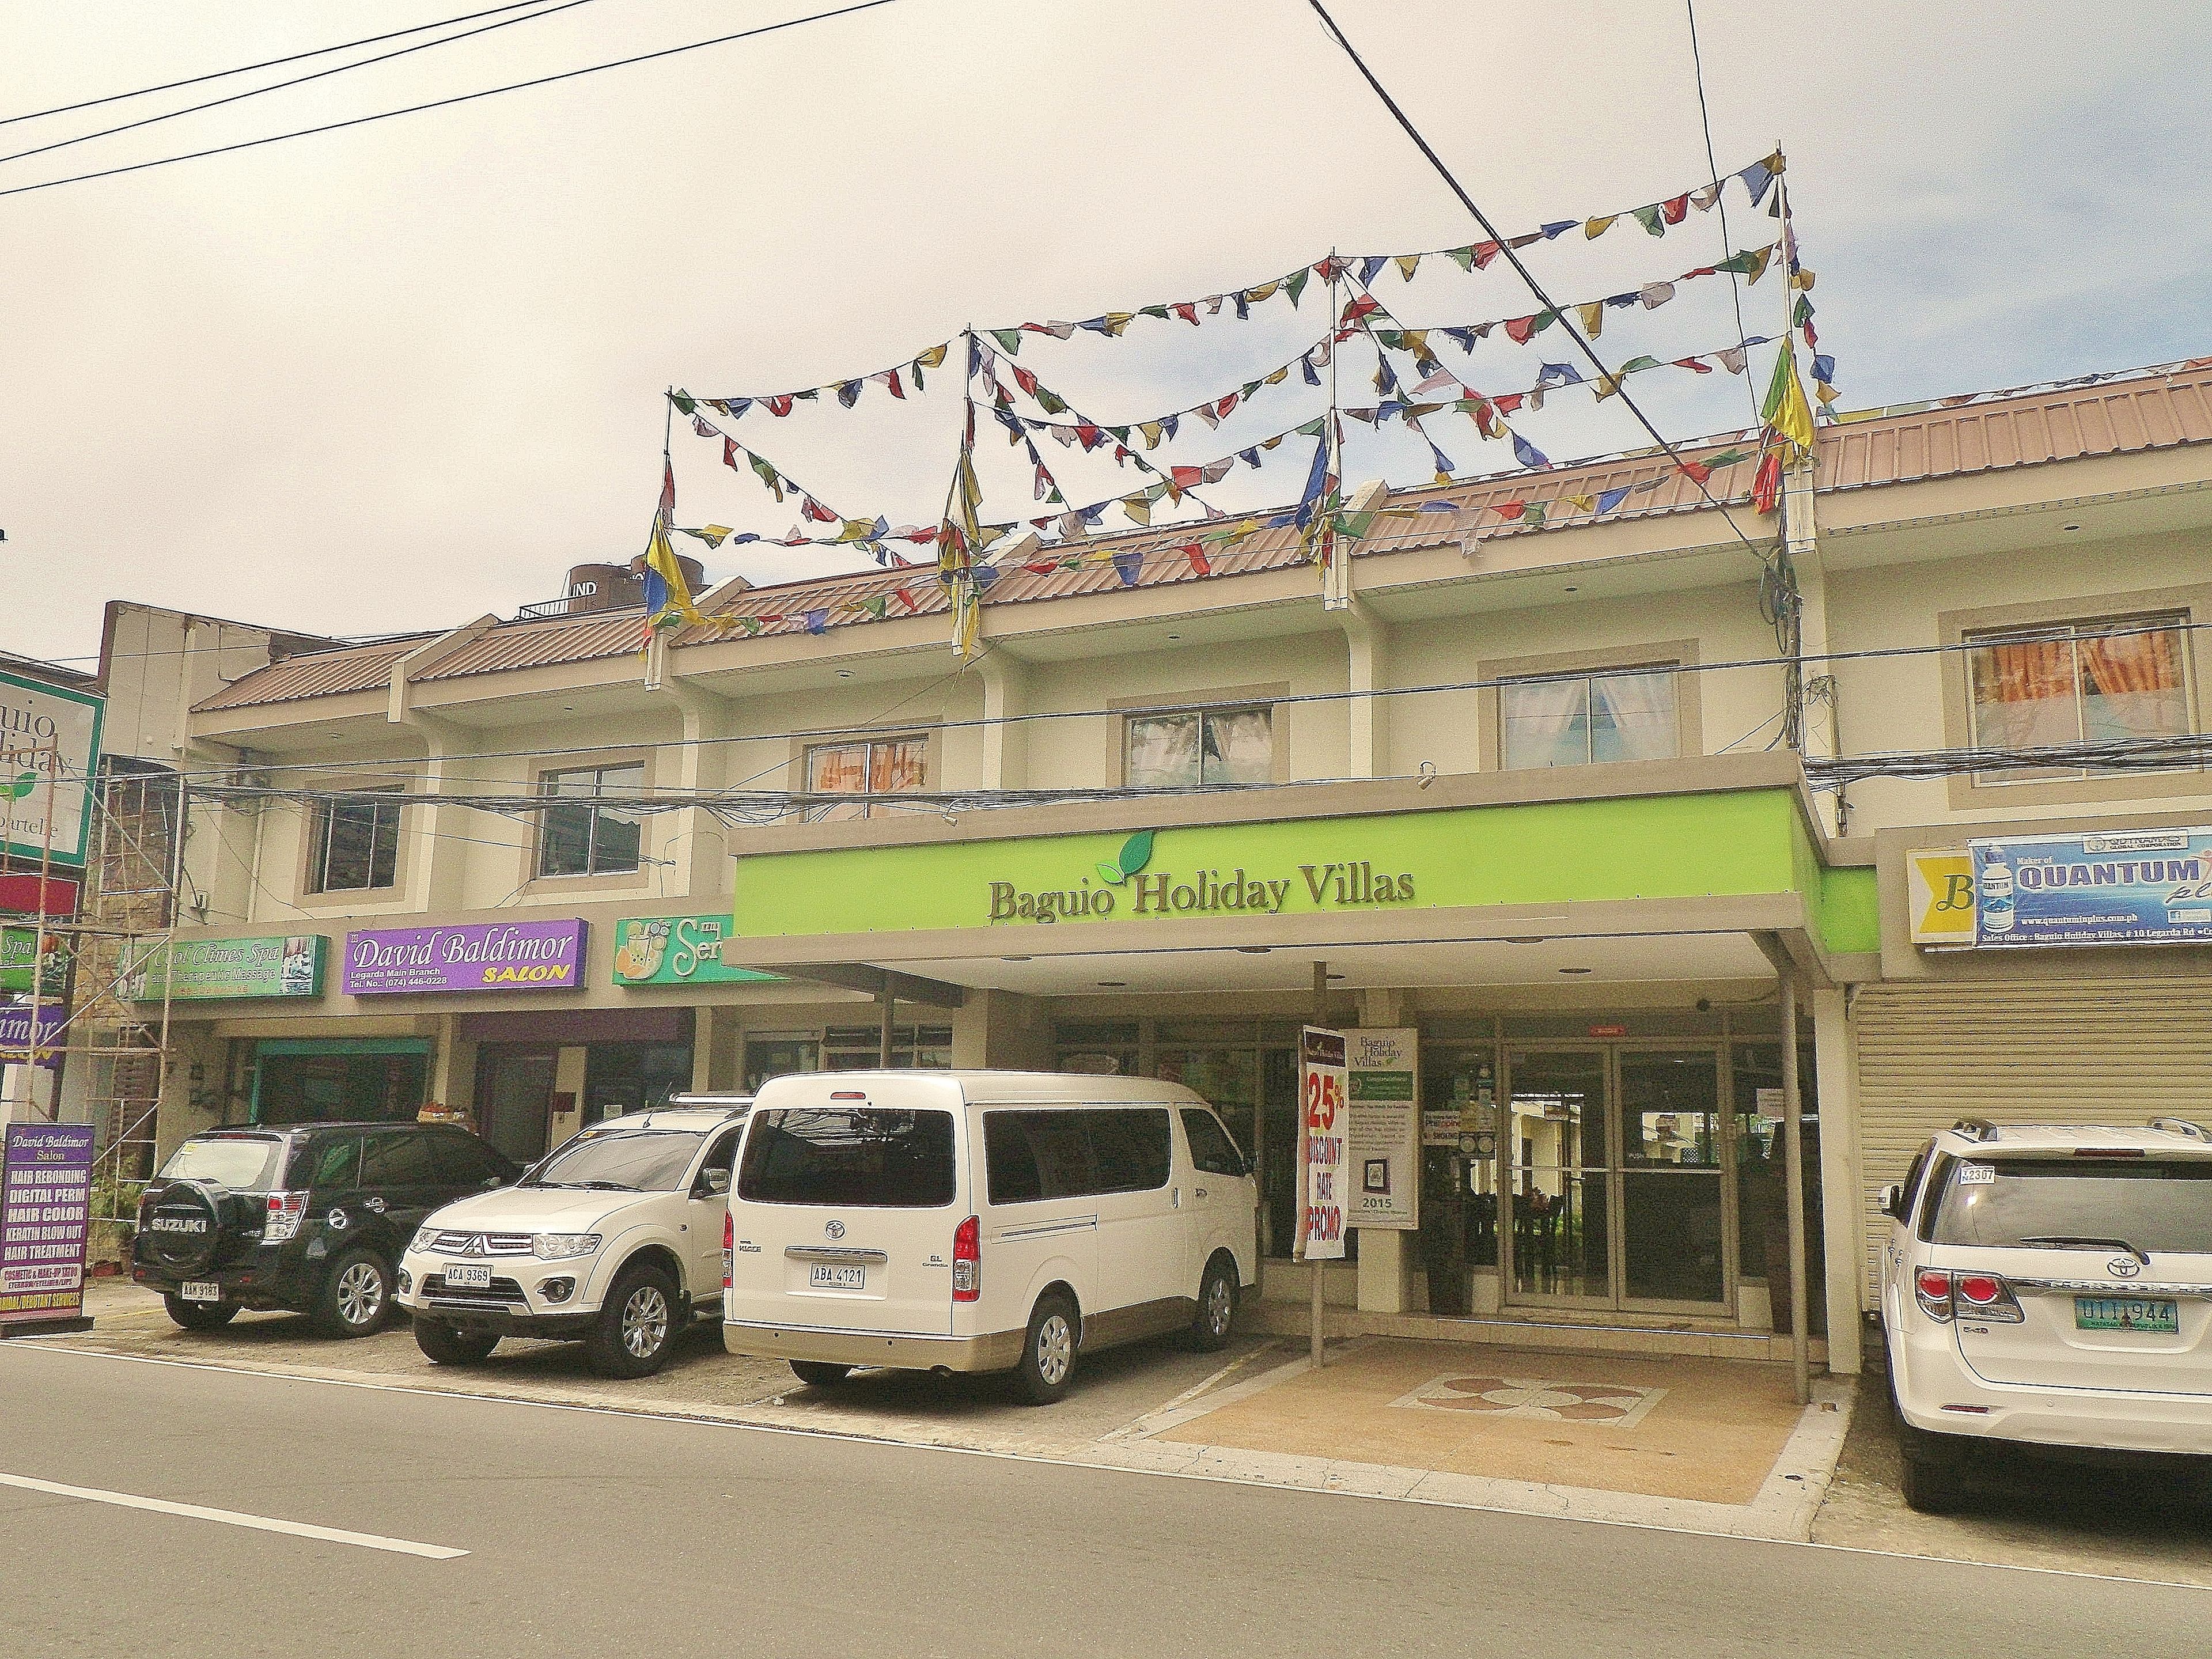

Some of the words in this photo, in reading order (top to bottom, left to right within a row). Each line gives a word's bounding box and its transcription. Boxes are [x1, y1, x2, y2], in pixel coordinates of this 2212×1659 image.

[2017, 857, 2041, 866] Maker
[2044, 856, 2054, 865] of
[2019, 859, 2199, 890] QUANTUM
[987, 877, 1115, 923] Baguio
[1132, 869, 1290, 914] Holiday
[1298, 861, 1415, 904] Villas
[1936, 874, 1974, 912] B
[1982, 933, 2003, 942] Sales
[2004, 933, 2027, 942] Office
[2035, 931, 2063, 941] Baguio
[2065, 930, 2098, 941] Holiday
[2134, 929, 2145, 938] 10
[2146, 927, 2181, 938] Legarda
[2182, 927, 2194, 936] Rd
[3, 935, 31, 960] Spa
[154, 944, 194, 967] Col
[193, 942, 244, 966] Climes
[247, 944, 279, 967] Spa
[353, 930, 442, 969] David
[441, 926, 573, 964] Baldimor
[232, 967, 276, 983] Massage
[350, 971, 385, 980] Legarda
[387, 969, 407, 977] Main
[408, 968, 440, 976] Branch
[350, 980, 363, 988] Tel.
[385, 979, 407, 987] (074)
[408, 976, 448, 986] 446-0228
[482, 964, 571, 983] SALON
[1308, 1072, 1345, 1130] 25%
[12, 1133, 46, 1148] David
[46, 1134, 89, 1148] Baldimor
[37, 1150, 65, 1161] Salon
[1308, 1136, 1342, 1165] DISCOUNT
[11, 1170, 33, 1185] HAIR
[35, 1169, 86, 1184] REBONDING
[1969, 1169, 1994, 1180] 2307
[1317, 1172, 1332, 1200] RATE
[9, 1188, 52, 1204] DIGITAL
[55, 1188, 85, 1203] PERM
[1362, 1198, 1392, 1208] 2015
[7, 1207, 40, 1224] HAIR
[42, 1206, 84, 1222] COLOR
[1308, 1206, 1341, 1241] PROMO
[6, 1226, 41, 1243] KERATIN
[41, 1225, 66, 1241] BLOW
[66, 1225, 83, 1240] OUT
[151, 1218, 207, 1233] SUZUKI
[4, 1245, 28, 1262] HAIR
[29, 1243, 82, 1260] TREATMENT
[448, 1268, 463, 1280] ACA
[467, 1269, 488, 1281] 9369
[813, 1267, 832, 1281] ABA
[836, 1269, 861, 1283] 4121
[2132, 1301, 2170, 1322] 944
